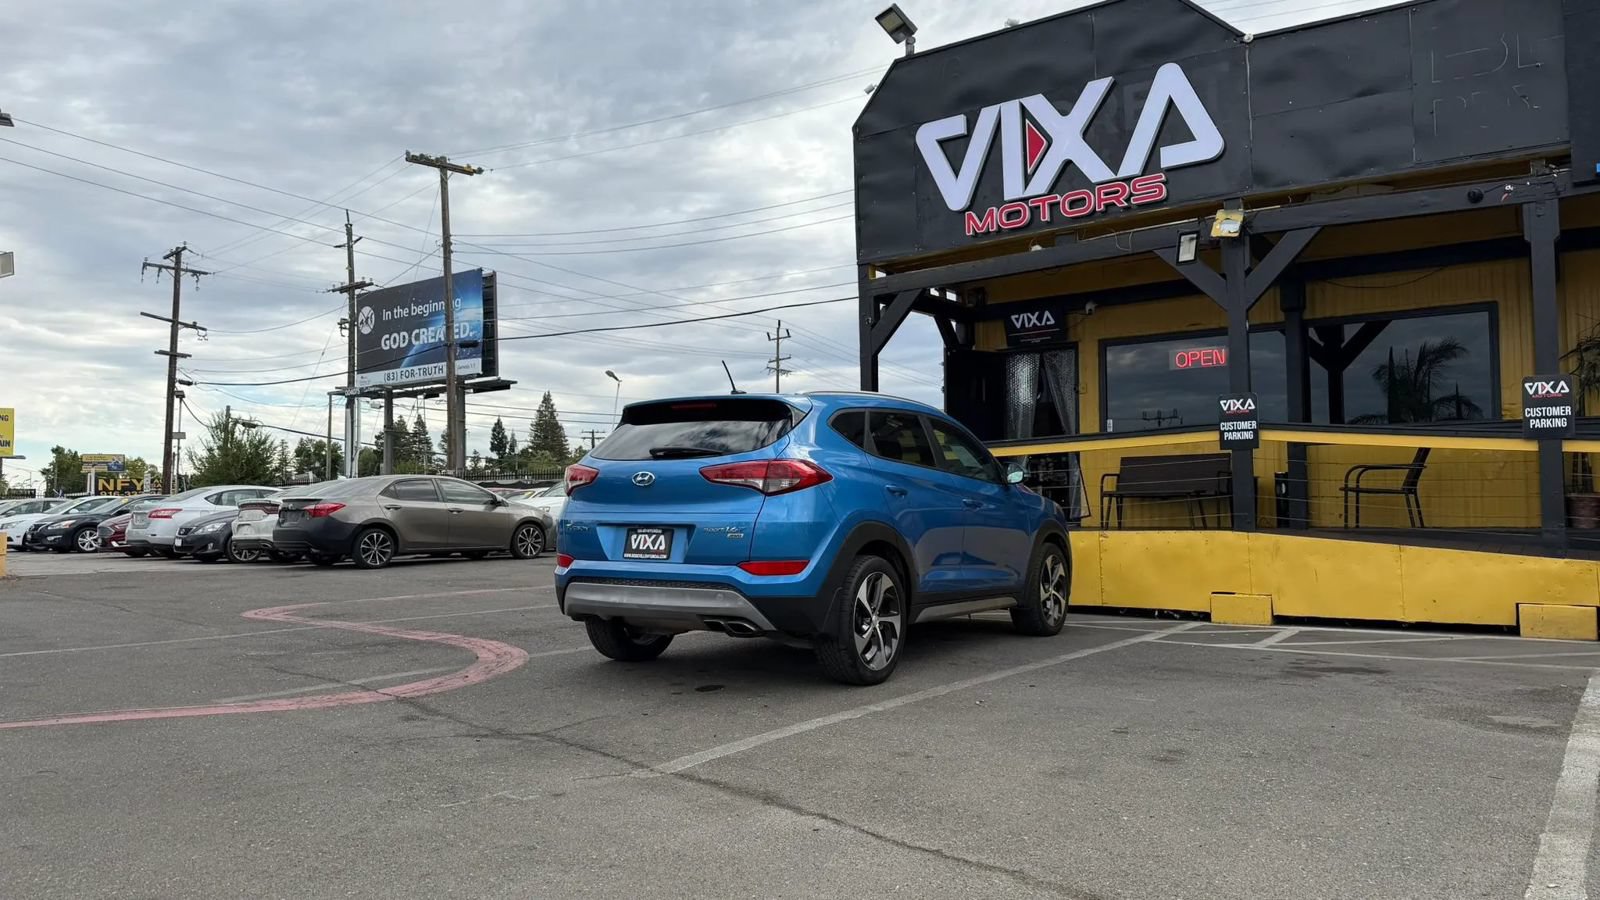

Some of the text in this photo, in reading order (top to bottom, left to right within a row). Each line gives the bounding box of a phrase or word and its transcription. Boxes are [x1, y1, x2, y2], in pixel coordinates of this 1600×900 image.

[916, 62, 1224, 211] VIXA
[965, 173, 1167, 236] MOTORS
[382, 308, 391, 321] In
[393, 306, 409, 319] the
[1010, 310, 1056, 329] VIXA
[381, 322, 473, 350] GOD CREAED.
[1175, 348, 1226, 368] OPEN
[383, 371, 399, 382] (83)
[400, 365, 444, 379] FOR-TRUTH
[1523, 380, 1570, 395] VIXA
[1220, 398, 1256, 411] VIXA
[1524, 405, 1572, 418] CUSTOMER
[1220, 420, 1257, 431] CUSTOMER
[1529, 417, 1568, 429] PARKING
[1224, 431, 1254, 440] PARKING
[98, 479, 145, 491] NFY
[631, 534, 666, 550] VIXA
